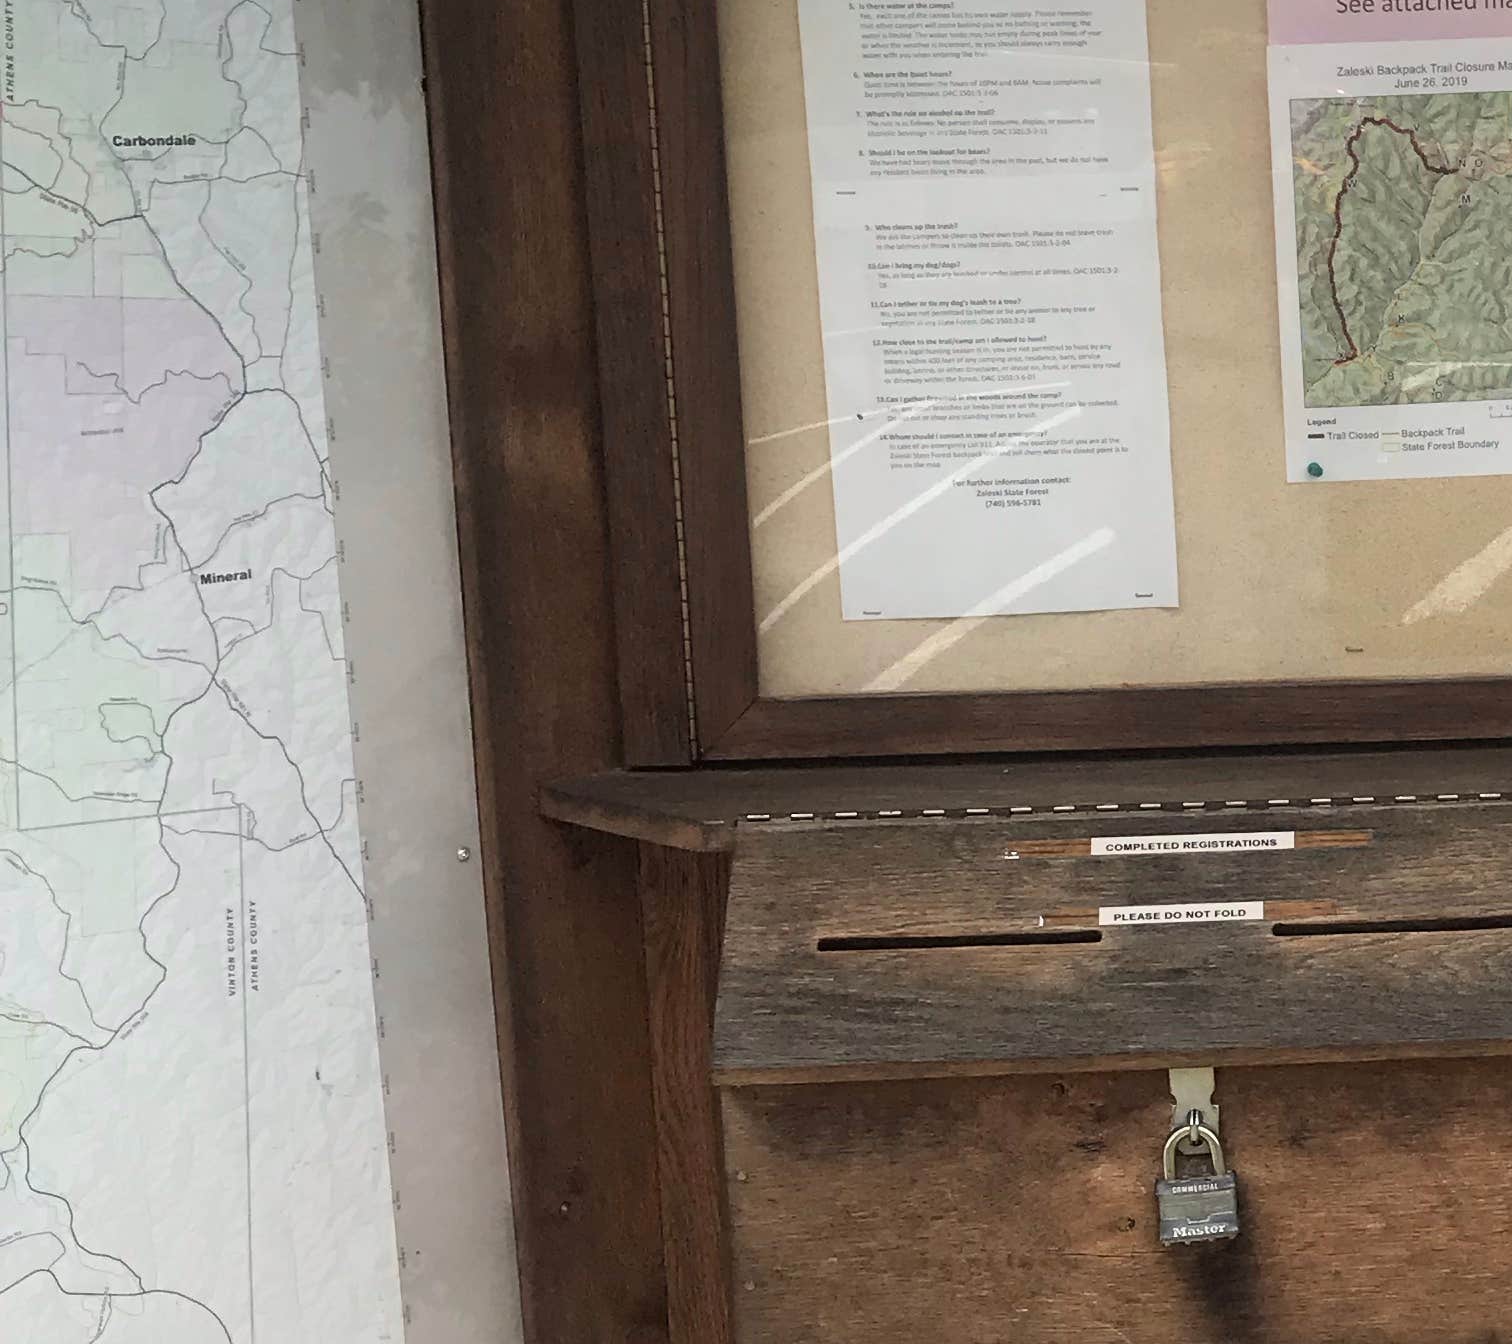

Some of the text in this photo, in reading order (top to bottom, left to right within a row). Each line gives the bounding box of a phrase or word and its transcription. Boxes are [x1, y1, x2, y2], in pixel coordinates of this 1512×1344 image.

[111, 133, 196, 150] Carbondale
[200, 569, 252, 585] Mineral
[1106, 838, 1279, 852] COMPLETED REGISTRATIONS
[1114, 908, 1247, 922] PLEASE DO NOT FOLD
[1172, 1223, 1226, 1238] Master
